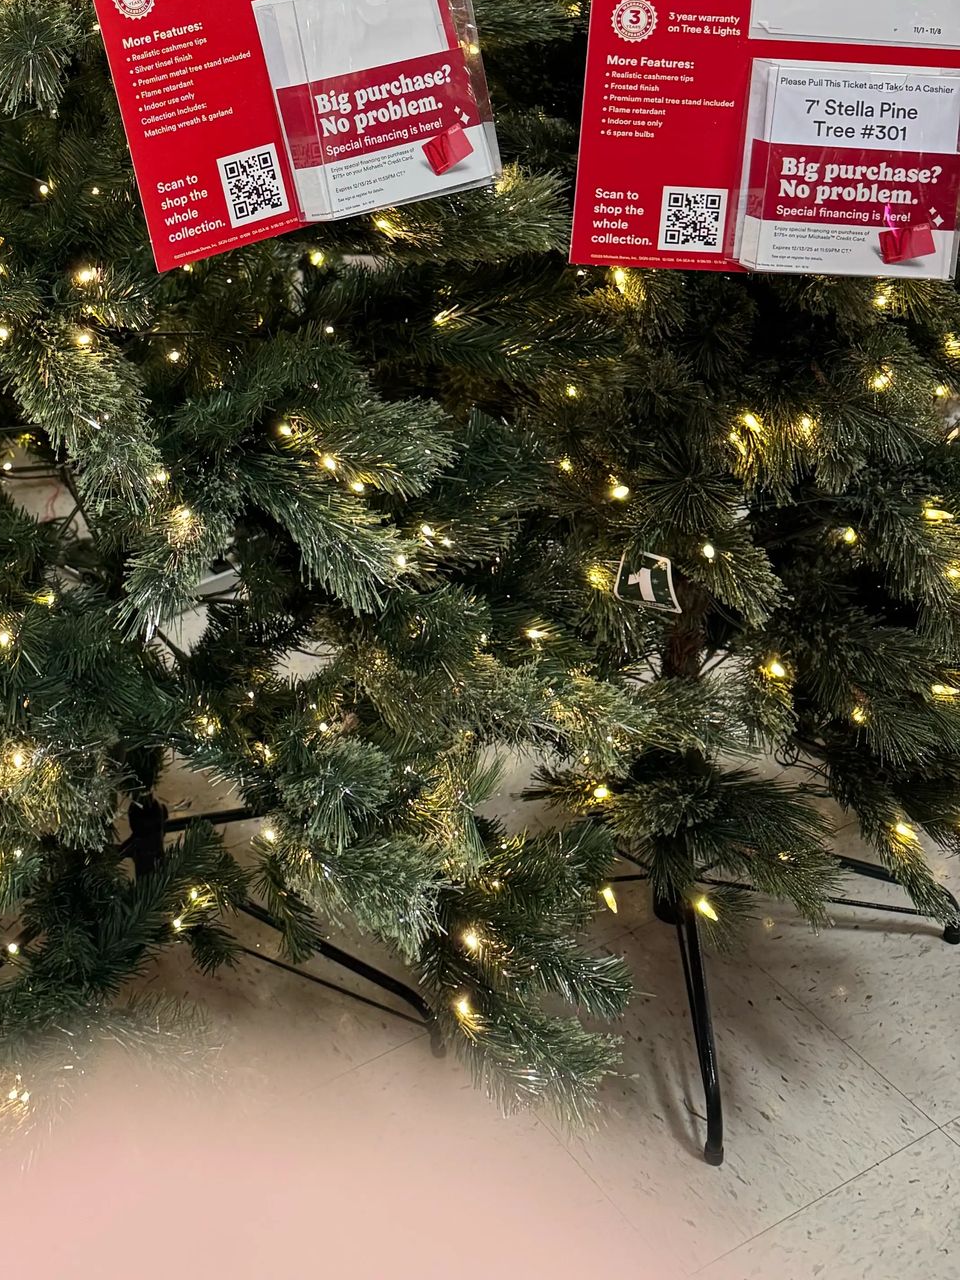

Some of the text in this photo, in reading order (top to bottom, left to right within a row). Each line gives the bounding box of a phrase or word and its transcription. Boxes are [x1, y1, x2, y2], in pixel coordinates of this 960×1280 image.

[135, 53, 193, 74] Silver tinsel finish
[607, 55, 694, 69] More Features:
[141, 79, 194, 99] Flame retardant
[314, 65, 451, 114] Big purchase?
[781, 77, 807, 86] Please
[808, 78, 823, 87] Pull
[824, 79, 841, 88] This
[842, 80, 867, 89] Ticket
[868, 82, 884, 90] and
[905, 84, 914, 92] to
[914, 84, 922, 92] A
[923, 85, 954, 94] Cashier
[141, 103, 207, 125] Collection Includes:
[320, 96, 443, 137] No problem.
[805, 99, 918, 119] 7' Stella Pine
[144, 107, 233, 138] Matching wreath & garland
[813, 120, 907, 141] Tree #301
[326, 138, 363, 156] Special
[364, 129, 409, 146] financing
[409, 125, 418, 135] is
[419, 117, 443, 132] here!
[780, 157, 942, 185] Big purchase?
[779, 180, 919, 205] No problem.
[776, 205, 817, 217] Special
[819, 207, 869, 222] financing
[872, 210, 881, 221] is
